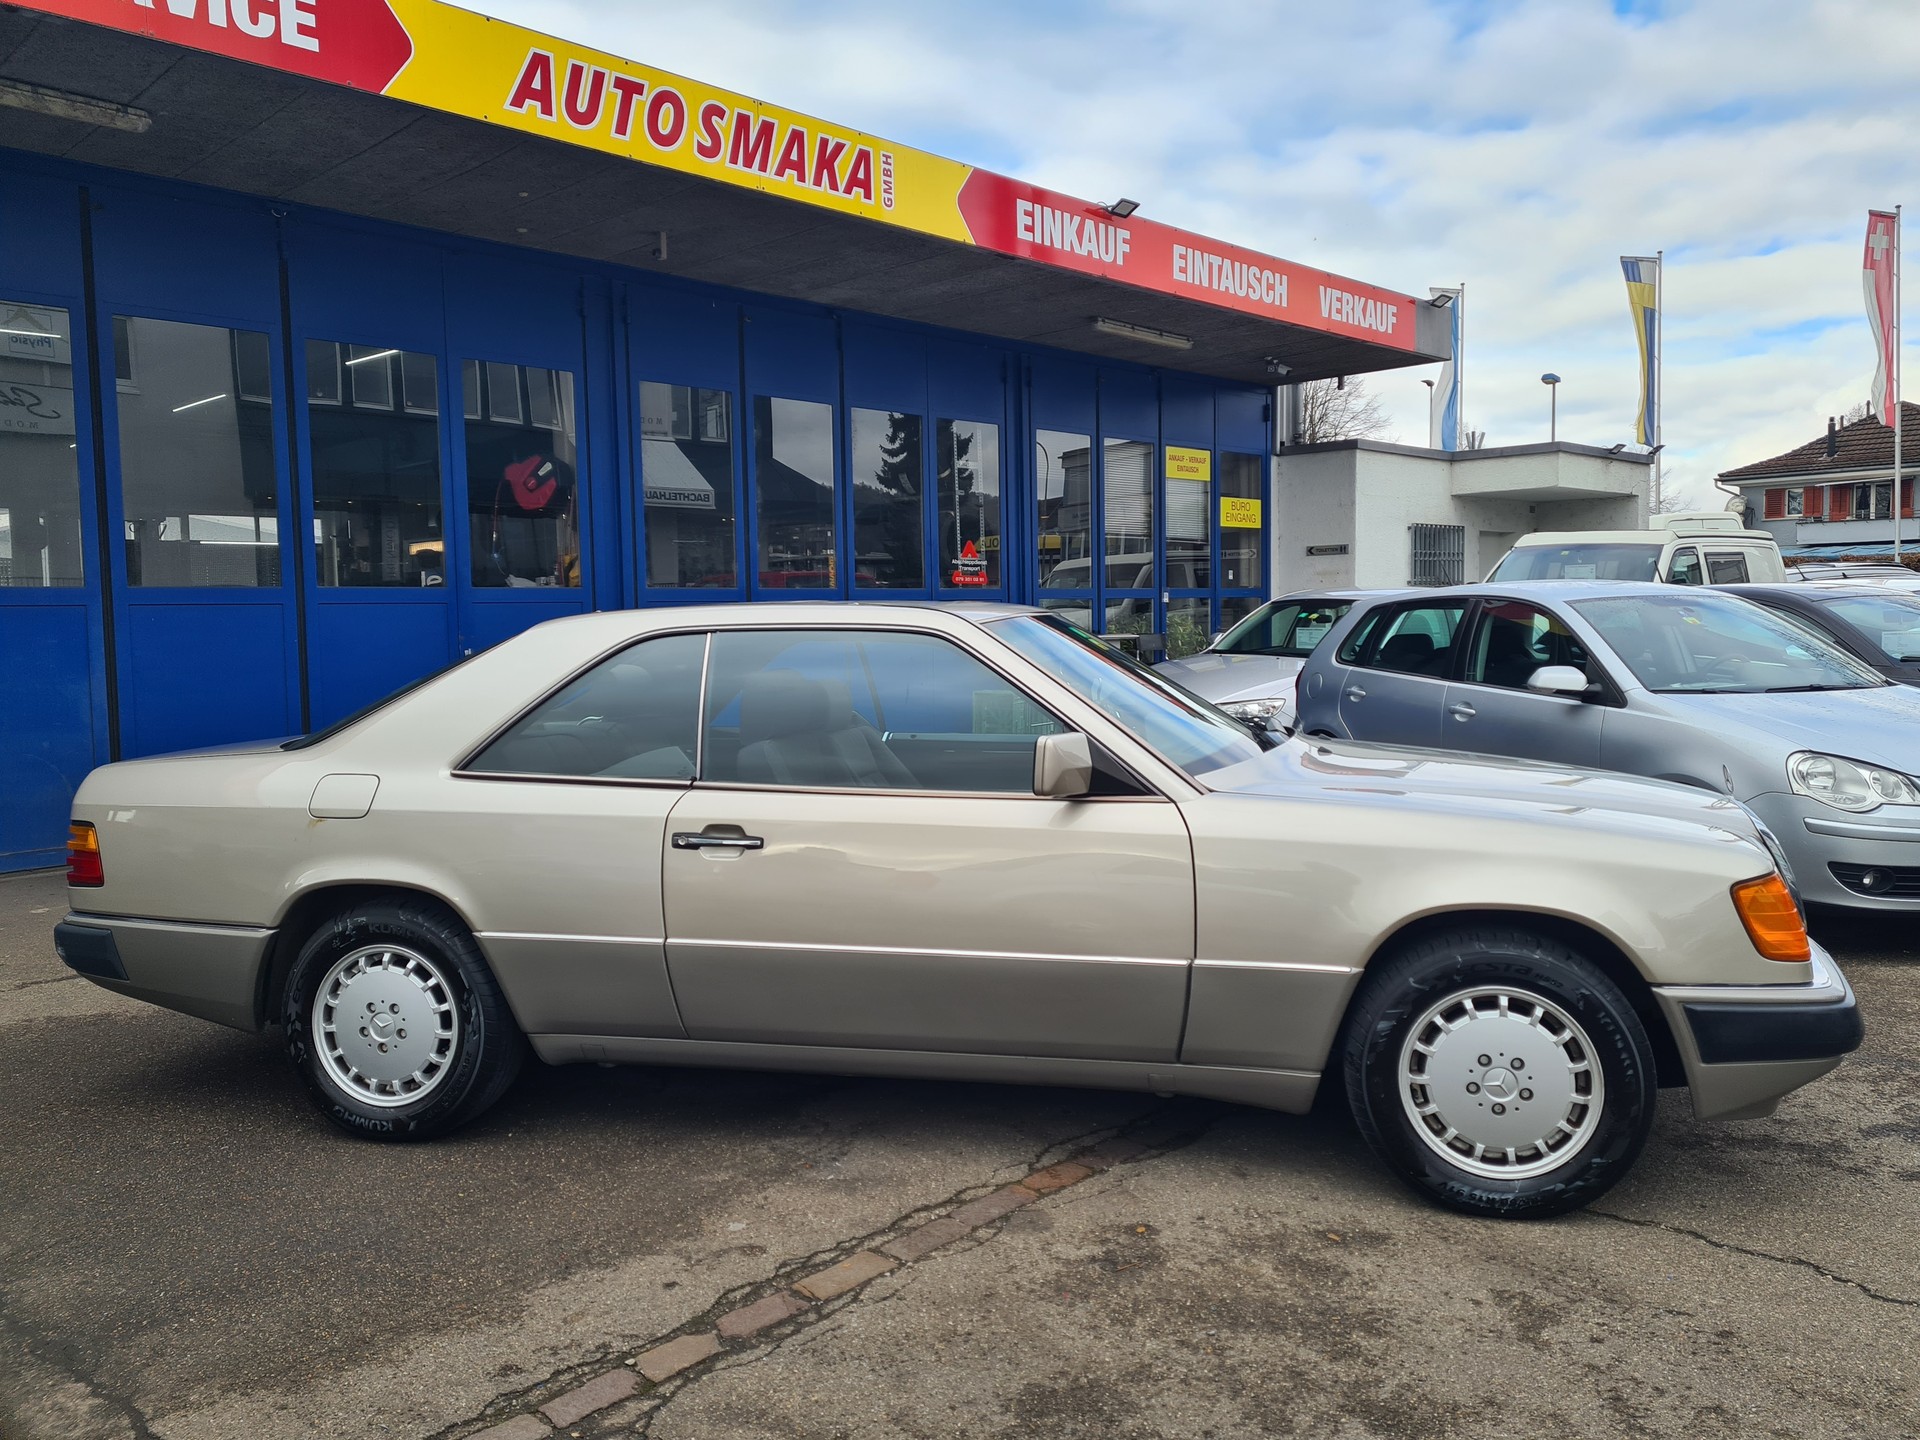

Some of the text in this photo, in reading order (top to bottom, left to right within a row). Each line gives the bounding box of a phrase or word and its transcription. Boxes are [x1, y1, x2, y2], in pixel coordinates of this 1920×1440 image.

[505, 48, 874, 203] AUTO SMAKA
[881, 151, 895, 209] GMBH
[1016, 198, 1397, 334] EINKAUF EINTAUSCH VERKAUF
[1168, 454, 1185, 463] ANKAUF
[1188, 456, 1207, 464] VERKAUF
[1176, 464, 1200, 473] EINTAUSCH
[1231, 500, 1251, 512] BÜRO
[1225, 512, 1257, 524] EINGANG
[332, 1104, 394, 1133] KUMHO
